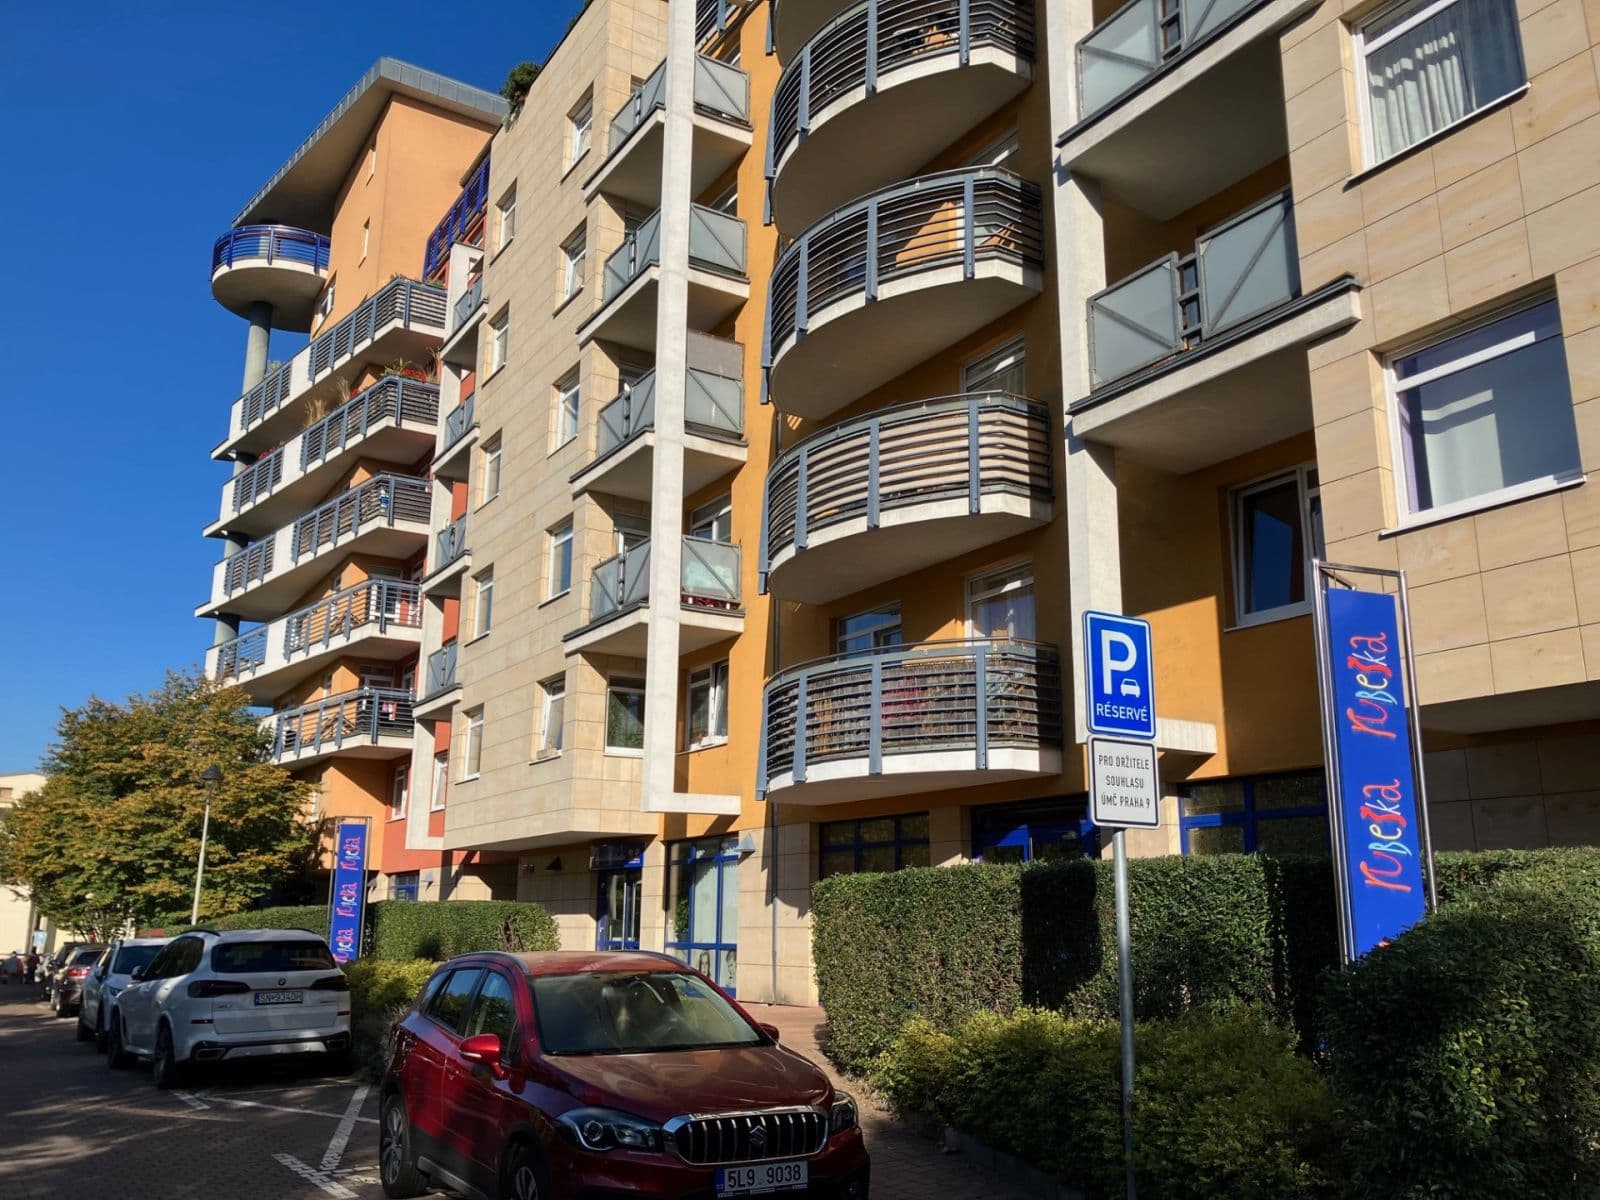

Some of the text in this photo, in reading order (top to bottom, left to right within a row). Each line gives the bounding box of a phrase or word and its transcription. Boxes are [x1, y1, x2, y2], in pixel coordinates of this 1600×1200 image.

[1101, 629, 1137, 695] P
[1096, 702, 1148, 721] RÉSERVÉ
[1098, 755, 1149, 769] PRO DRŽITELE
[1106, 775, 1144, 788] SOUHLASU
[1101, 792, 1150, 808] ÚMČ PRAHA 9
[728, 1164, 801, 1188] 5L9 9038
